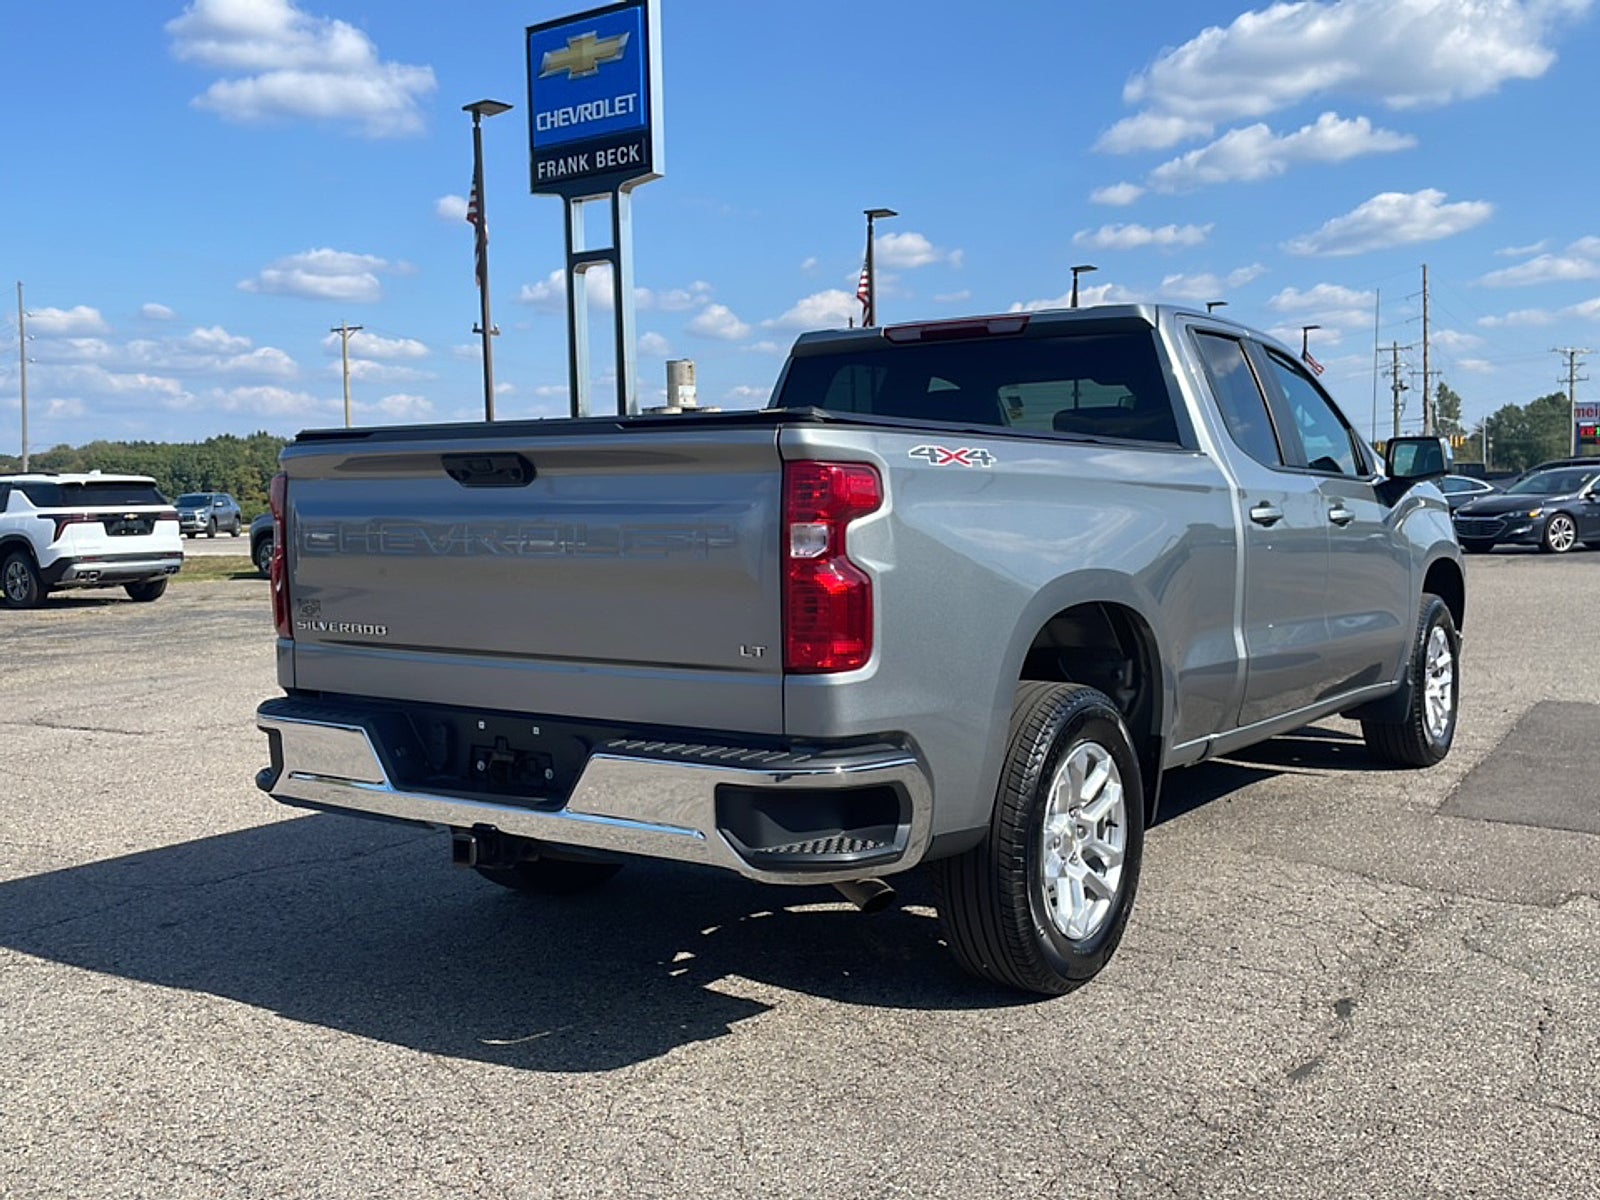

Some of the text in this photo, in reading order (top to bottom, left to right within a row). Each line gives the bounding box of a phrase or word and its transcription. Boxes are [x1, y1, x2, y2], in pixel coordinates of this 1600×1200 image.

[536, 93, 638, 132] CHEVROLET
[537, 144, 640, 180] FRANK BECK
[296, 620, 388, 636] SILVERADO
[740, 645, 767, 657] LT
